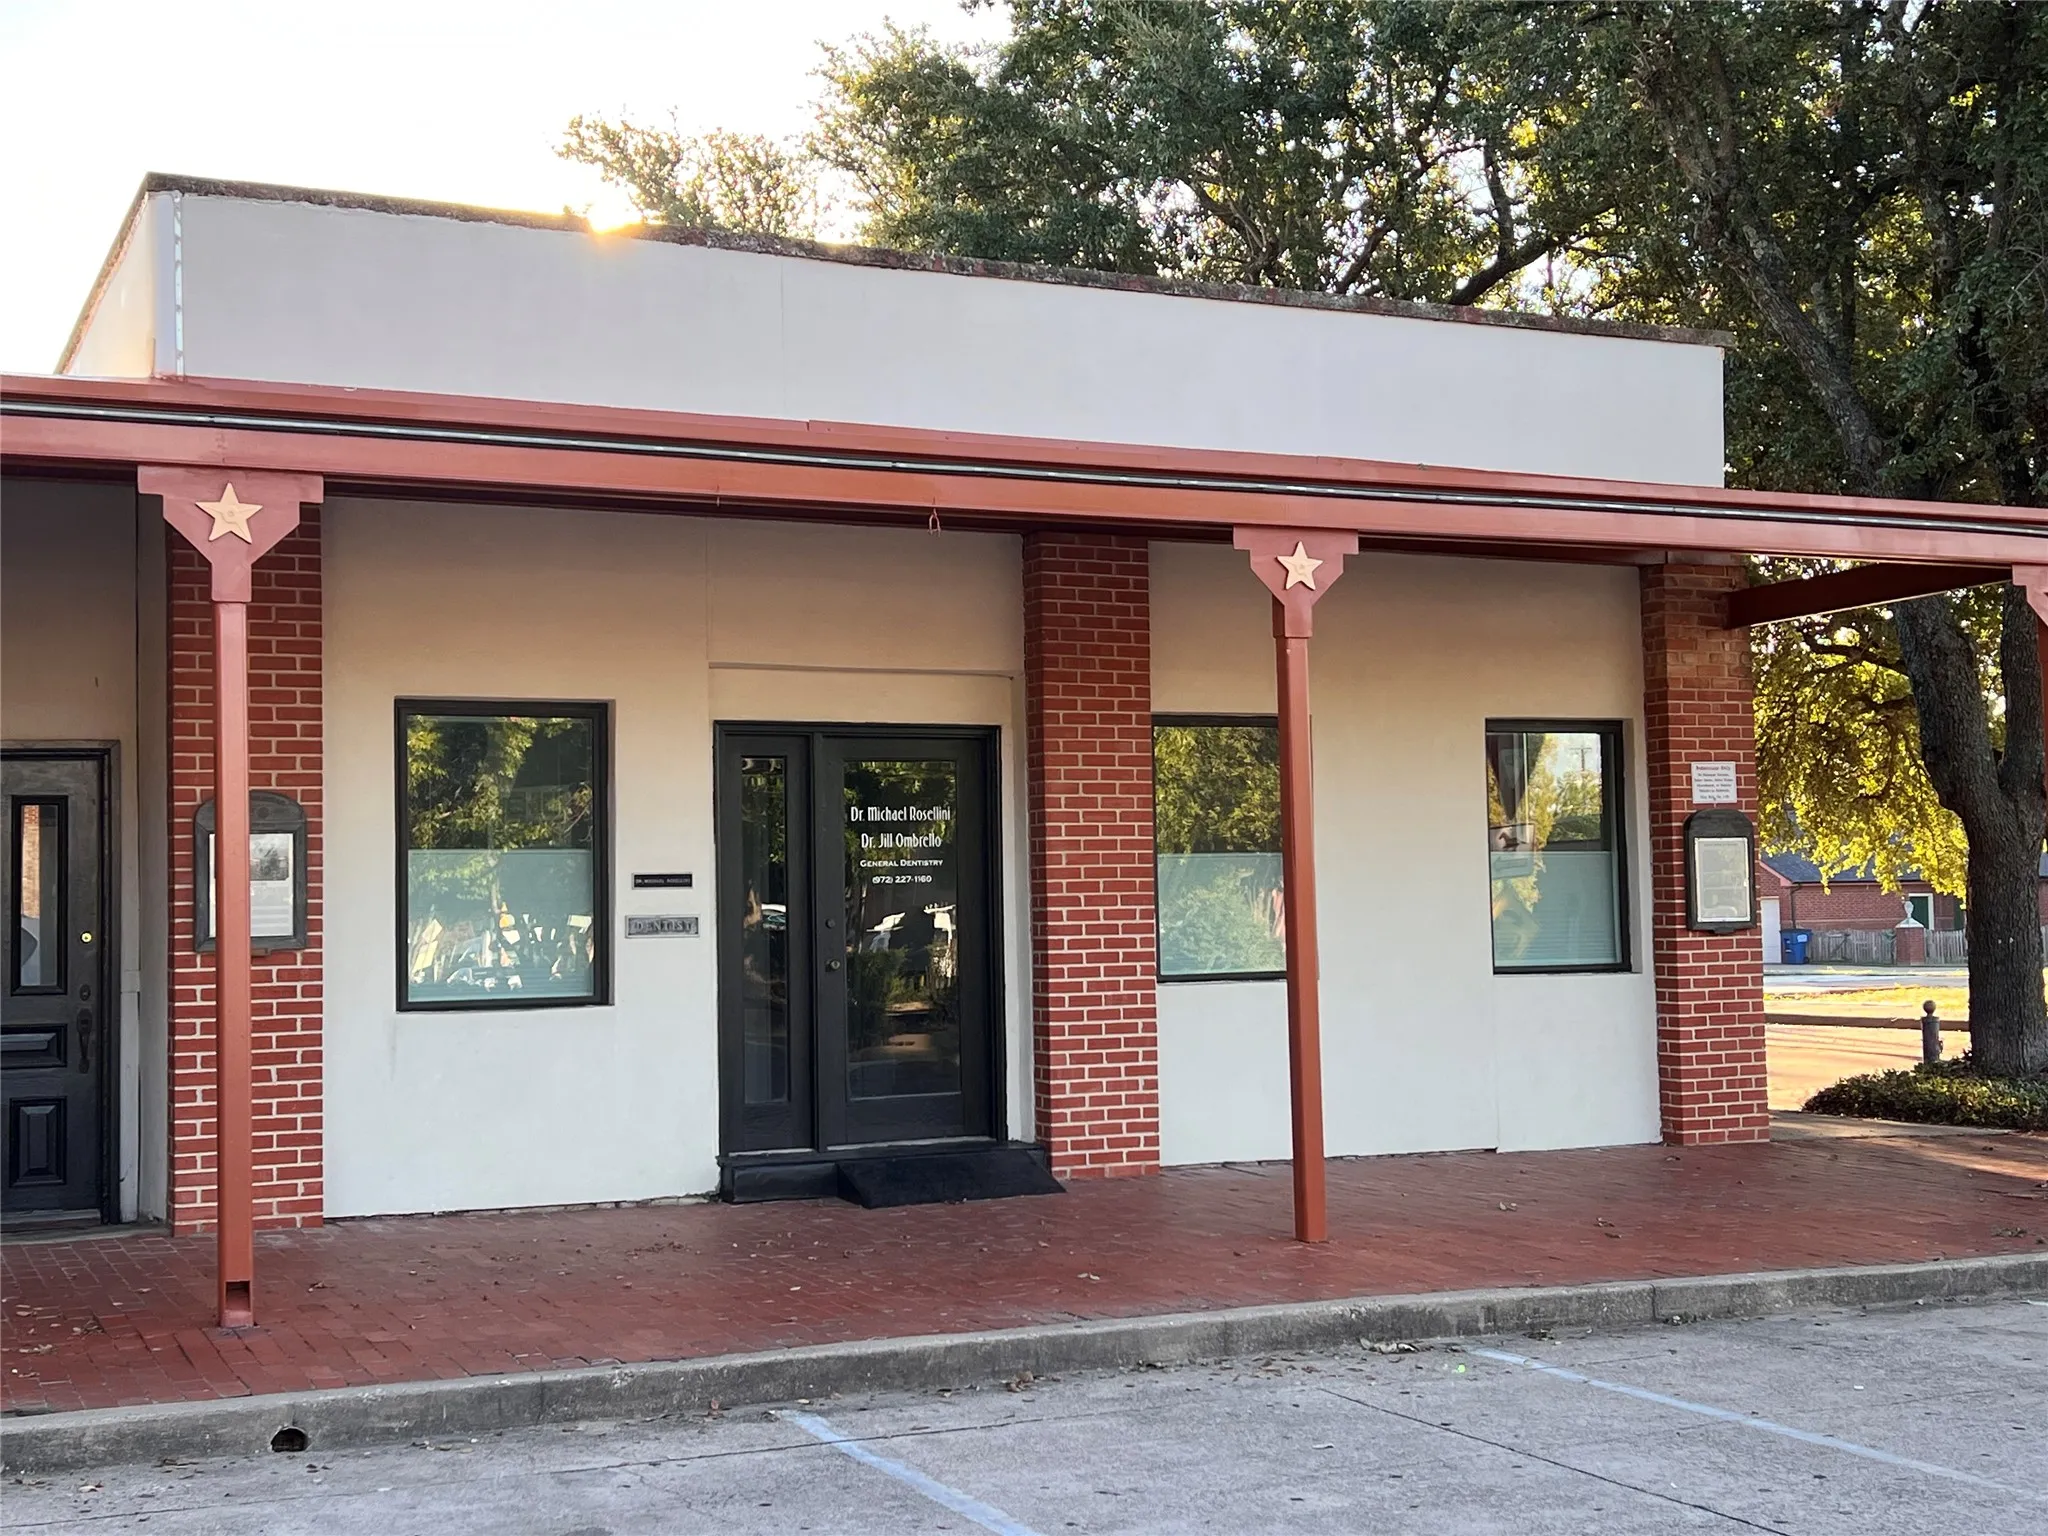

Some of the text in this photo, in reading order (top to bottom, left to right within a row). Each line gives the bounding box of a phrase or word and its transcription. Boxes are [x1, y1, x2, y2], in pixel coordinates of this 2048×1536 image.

[850, 806, 951, 821] Dr. Michael Rosellini
[861, 833, 942, 848] Dr. Jill Ombrello
[872, 875, 933, 884] (972) 227-1160
[635, 919, 691, 932] DENTIST
